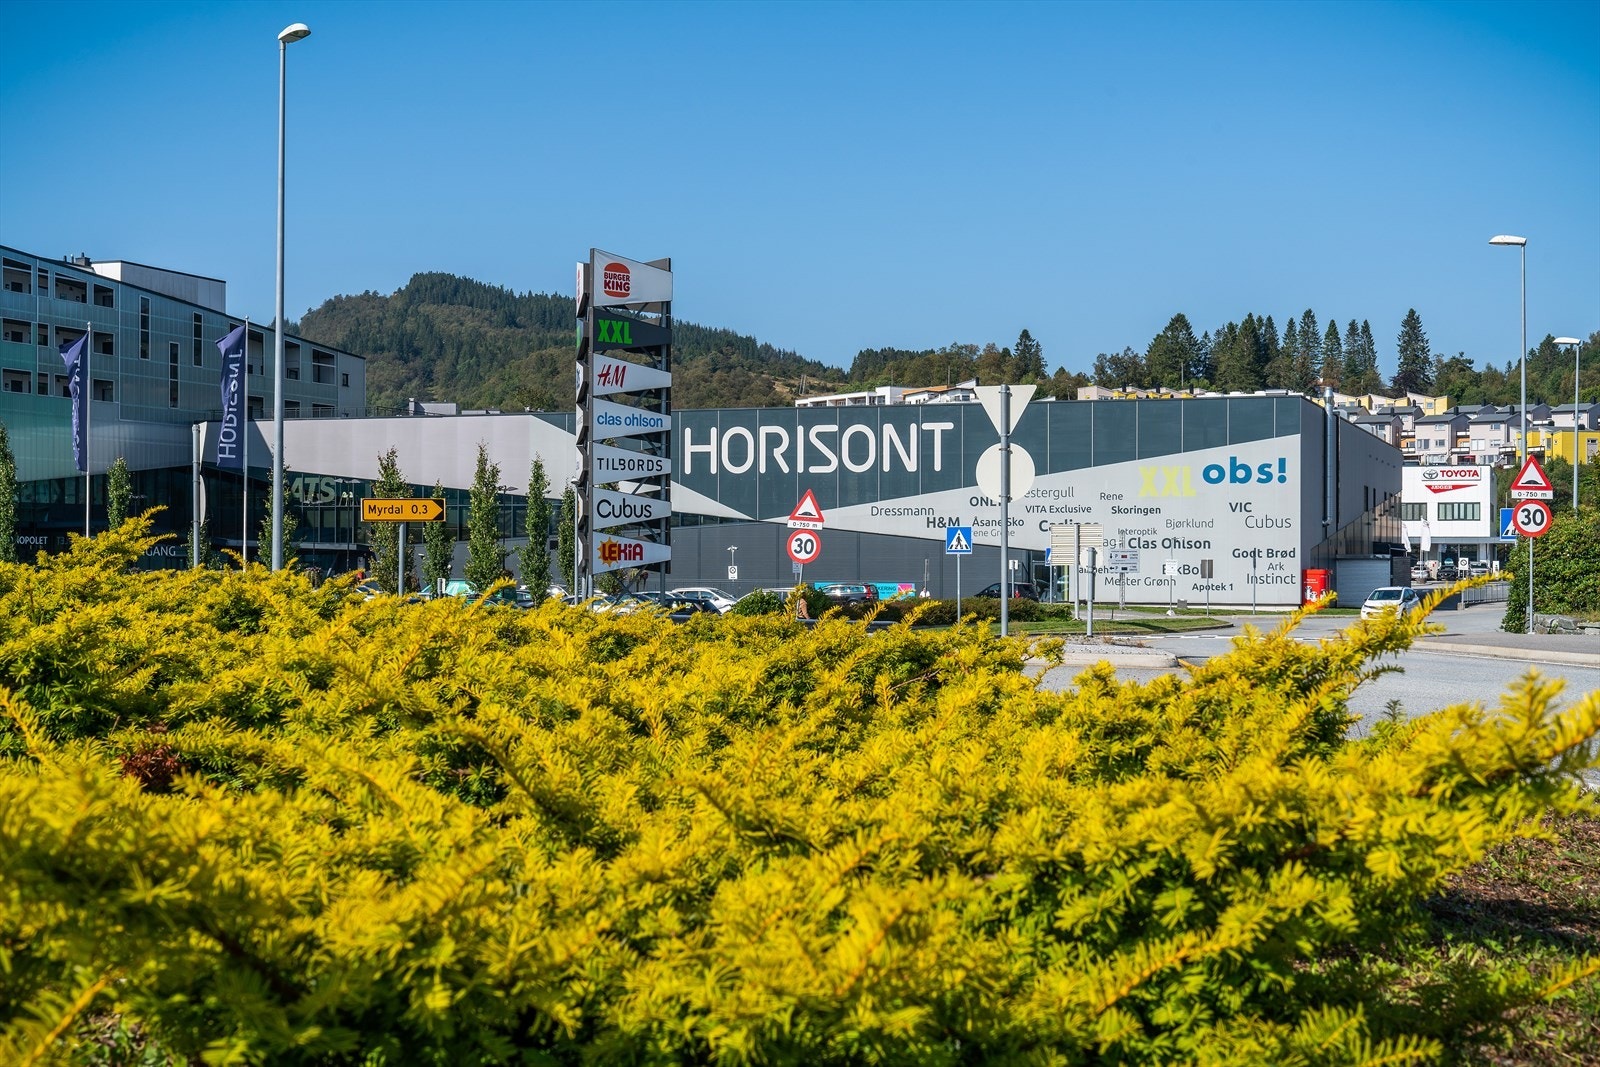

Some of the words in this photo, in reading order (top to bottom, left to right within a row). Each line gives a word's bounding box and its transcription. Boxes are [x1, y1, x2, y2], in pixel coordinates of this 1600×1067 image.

[603, 272, 630, 282] BURGER
[604, 280, 630, 292] KING
[598, 320, 632, 344] XXL
[597, 364, 626, 388] H&M
[597, 412, 622, 426] clas
[624, 414, 663, 428] ohlson
[684, 422, 954, 474] HORISONT
[597, 458, 662, 472] TILBORDS
[1202, 456, 1287, 484] obs!
[1440, 470, 1480, 478] TOYOTA
[1138, 466, 1196, 497] XXL
[291, 477, 336, 502] ATS
[1024, 486, 1074, 500] estergull
[969, 496, 1001, 506] ONL
[1100, 492, 1124, 500] Rene
[368, 504, 404, 516] Myrdal
[411, 504, 428, 515] 0.3
[596, 498, 652, 519] Cubus
[870, 506, 934, 516] Dressmann
[1025, 505, 1046, 514] VITA
[1049, 504, 1092, 514] Exclusive
[1111, 506, 1162, 516] Skoringen
[1228, 502, 1252, 512] VIC
[926, 516, 960, 528] H&M
[1244, 514, 1292, 528] Cubus
[1520, 508, 1545, 526] 30
[1166, 518, 1214, 530] Bjørklund
[990, 529, 1016, 537] Gre
[17, 536, 48, 544] OPOLET
[794, 538, 814, 554] 30
[1128, 536, 1156, 549] Clas
[1161, 537, 1211, 549] Ohlson
[146, 546, 176, 556] GANG
[1266, 548, 1296, 558] Brød
[1267, 562, 1285, 570] Ark
[1246, 572, 1296, 584] Instinct
[1192, 582, 1226, 592] Apotek
